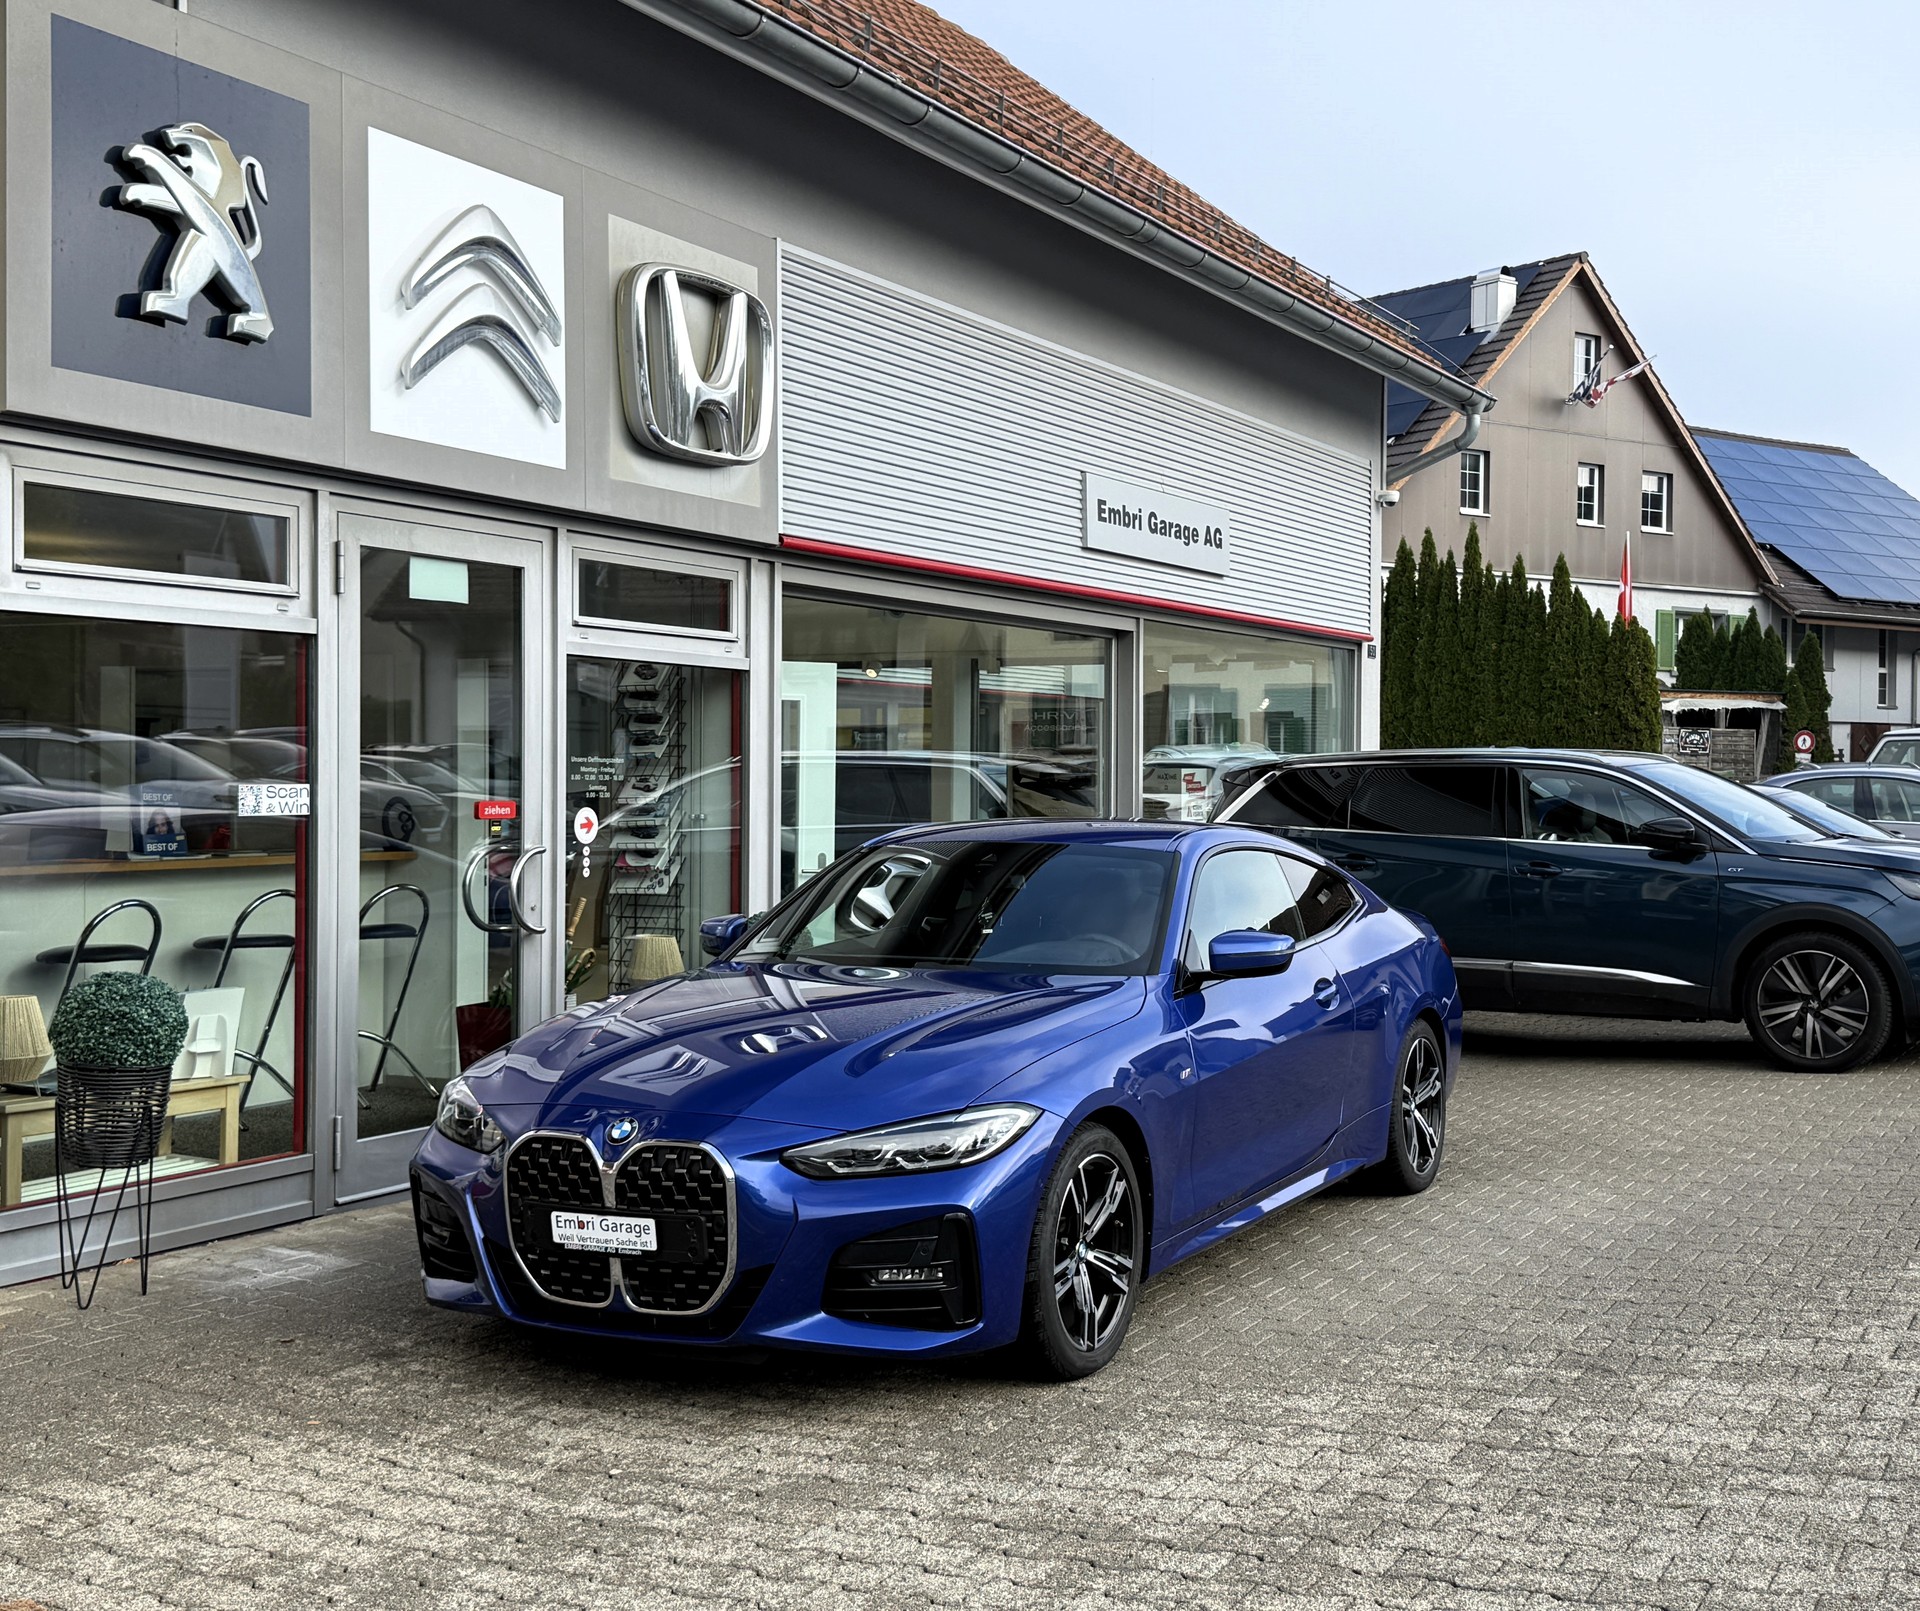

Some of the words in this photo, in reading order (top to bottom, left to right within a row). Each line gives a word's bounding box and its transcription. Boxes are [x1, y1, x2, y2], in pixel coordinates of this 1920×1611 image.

[1097, 498, 1142, 531] Embri
[1147, 511, 1199, 546] Garage
[1203, 525, 1223, 550] AG
[580, 766, 597, 774] Montag
[601, 766, 616, 774] Freitag
[143, 793, 163, 801] BEST
[163, 793, 173, 801] OF
[266, 785, 310, 799] Scan
[266, 804, 276, 814] &
[278, 800, 310, 814] Win
[484, 805, 511, 815] ziehen
[146, 843, 167, 851] BEST
[167, 843, 179, 851] OF
[555, 1215, 595, 1231] Embri
[599, 1218, 651, 1238] Garage
[558, 1233, 575, 1242] Weil
[576, 1234, 615, 1245] Vertrauen
[616, 1238, 638, 1248] Sache
[618, 1247, 642, 1256] Embrach
